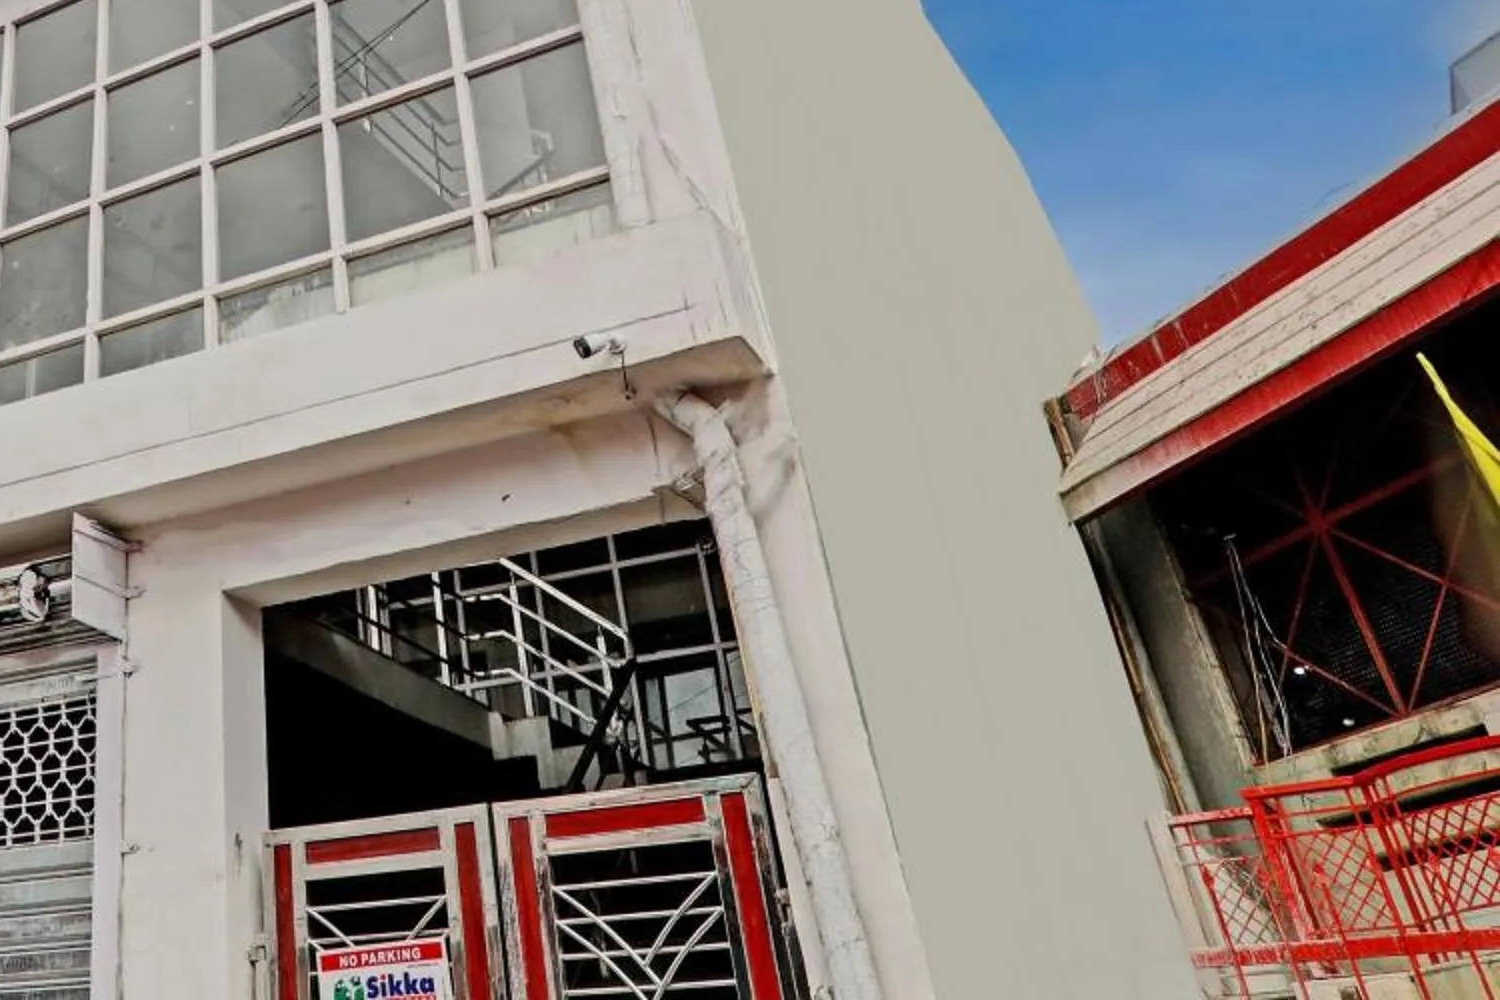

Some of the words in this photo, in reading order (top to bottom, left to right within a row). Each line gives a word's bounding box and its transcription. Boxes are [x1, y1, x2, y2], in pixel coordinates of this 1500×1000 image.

[339, 954, 358, 968] NO
[361, 947, 421, 965] PARKING
[366, 972, 435, 998] Sikka
